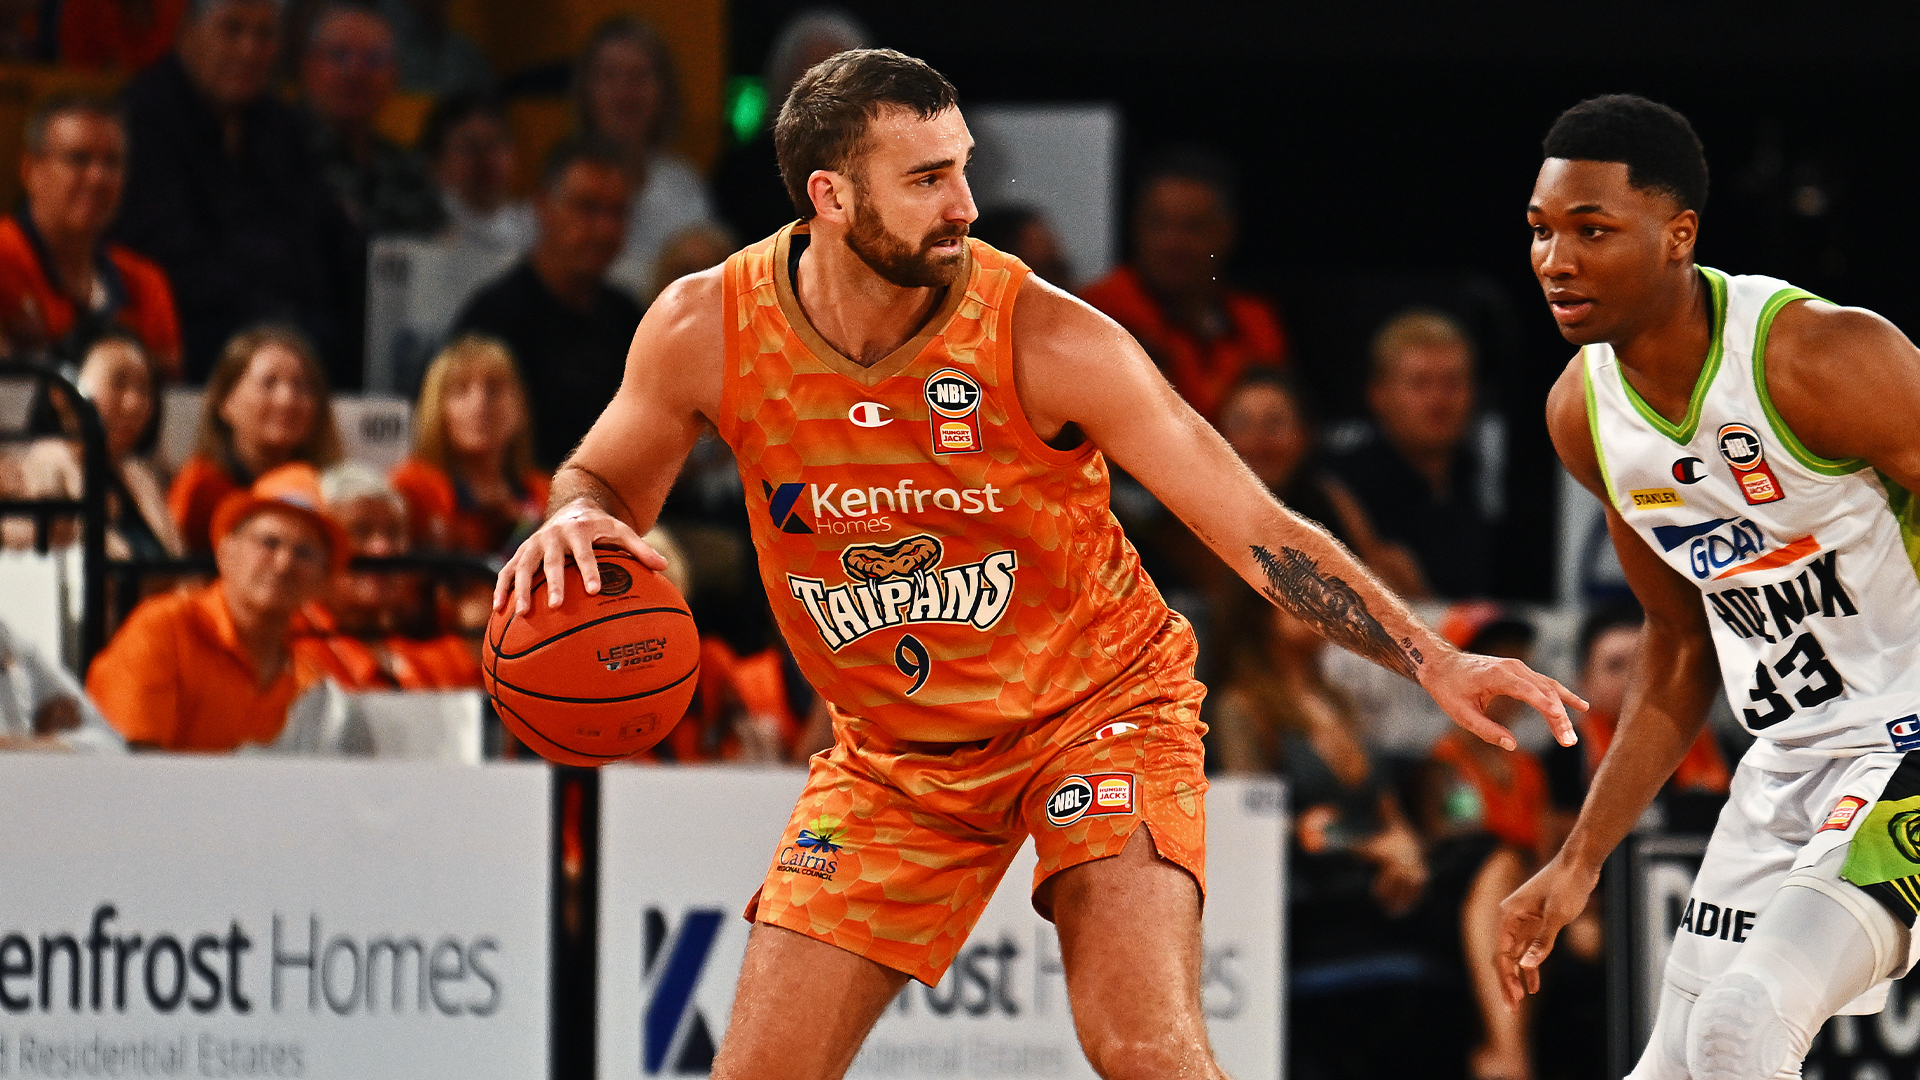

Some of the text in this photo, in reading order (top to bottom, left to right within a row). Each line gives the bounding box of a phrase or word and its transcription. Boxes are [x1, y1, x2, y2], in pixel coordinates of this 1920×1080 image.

[936, 383, 969, 404] NBL
[810, 478, 1004, 519] Kenfrost
[1633, 491, 1678, 507] STANLEY
[816, 515, 892, 535] Homes
[1690, 518, 1765, 579] GOAT
[787, 551, 1018, 654] TAIPANS
[597, 637, 667, 662] LEGACY
[894, 633, 931, 696] 9
[1743, 632, 1844, 731] 33
[1054, 788, 1083, 814] NBL
[780, 846, 838, 874] Cairns
[801, 868, 833, 881] COUNCIL
[270, 907, 500, 1017] Homes
[199, 1031, 307, 1078] Estates
